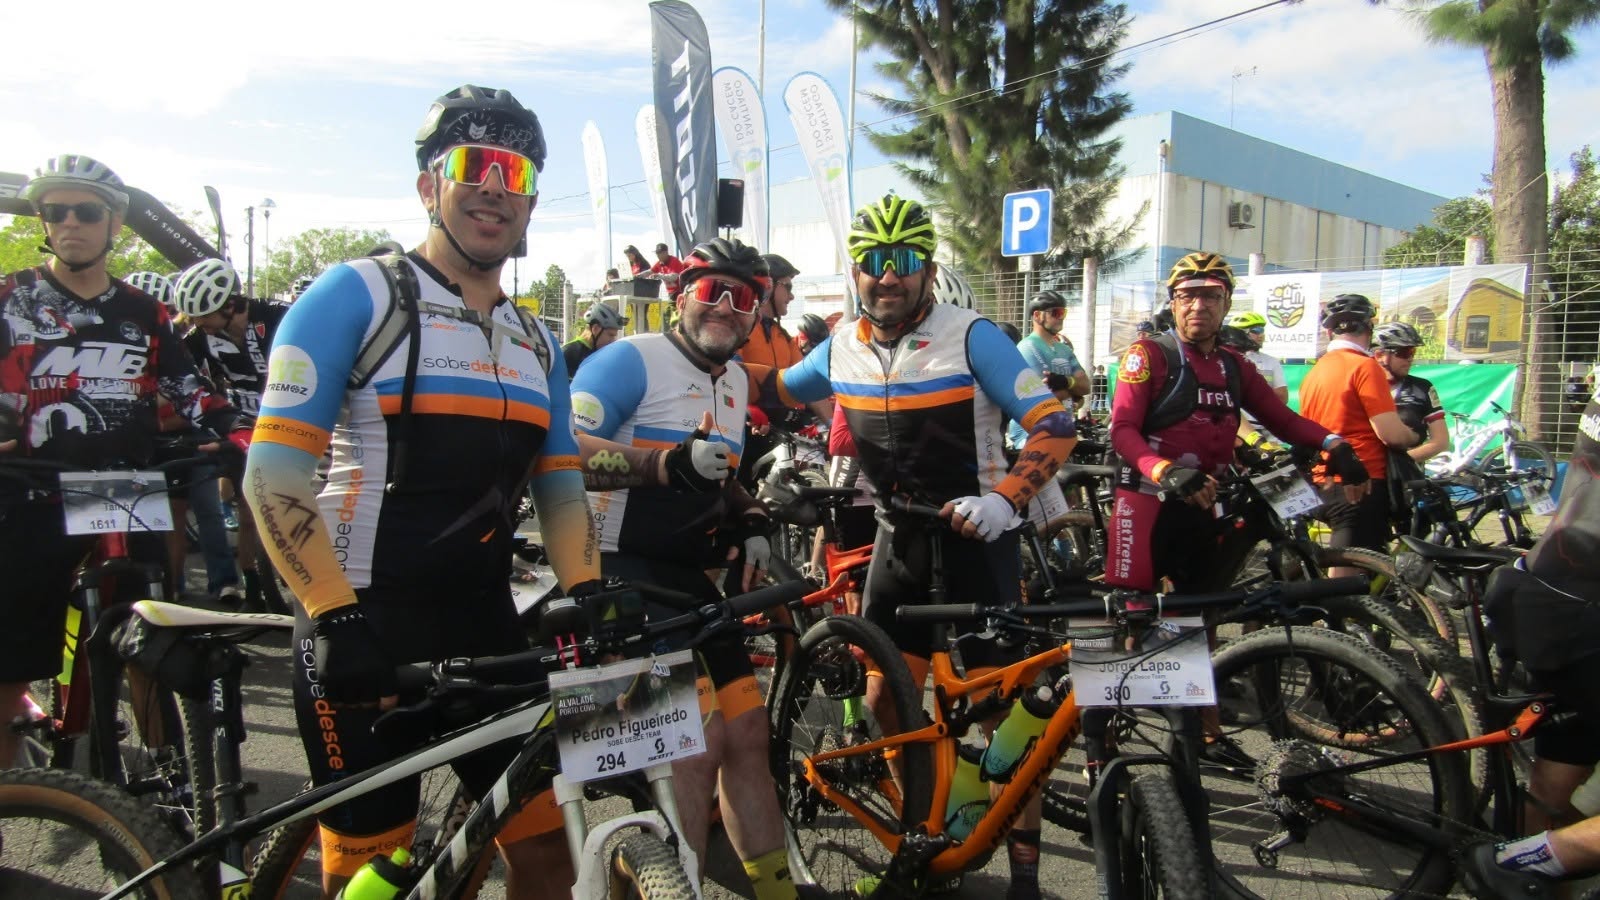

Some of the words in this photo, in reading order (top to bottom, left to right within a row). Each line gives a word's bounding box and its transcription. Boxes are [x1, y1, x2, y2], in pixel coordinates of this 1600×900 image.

[145, 208, 159, 222] NO
[1011, 197, 1041, 251] P
[31, 341, 149, 379] MTB
[31, 377, 67, 390] LOVE
[89, 518, 117, 530] 1611
[1120, 518, 1134, 579] BtTretas
[1104, 686, 1131, 701] 380
[558, 695, 594, 709] ALVALADE
[559, 704, 579, 717] PORTO
[579, 703, 596, 713] COVO
[572, 725, 615, 745] Pedro
[619, 708, 688, 737] Figueiredo
[607, 738, 624, 748] SOBE
[625, 734, 645, 745] DESCE
[645, 730, 661, 739] TEAM
[596, 751, 626, 773] 294
